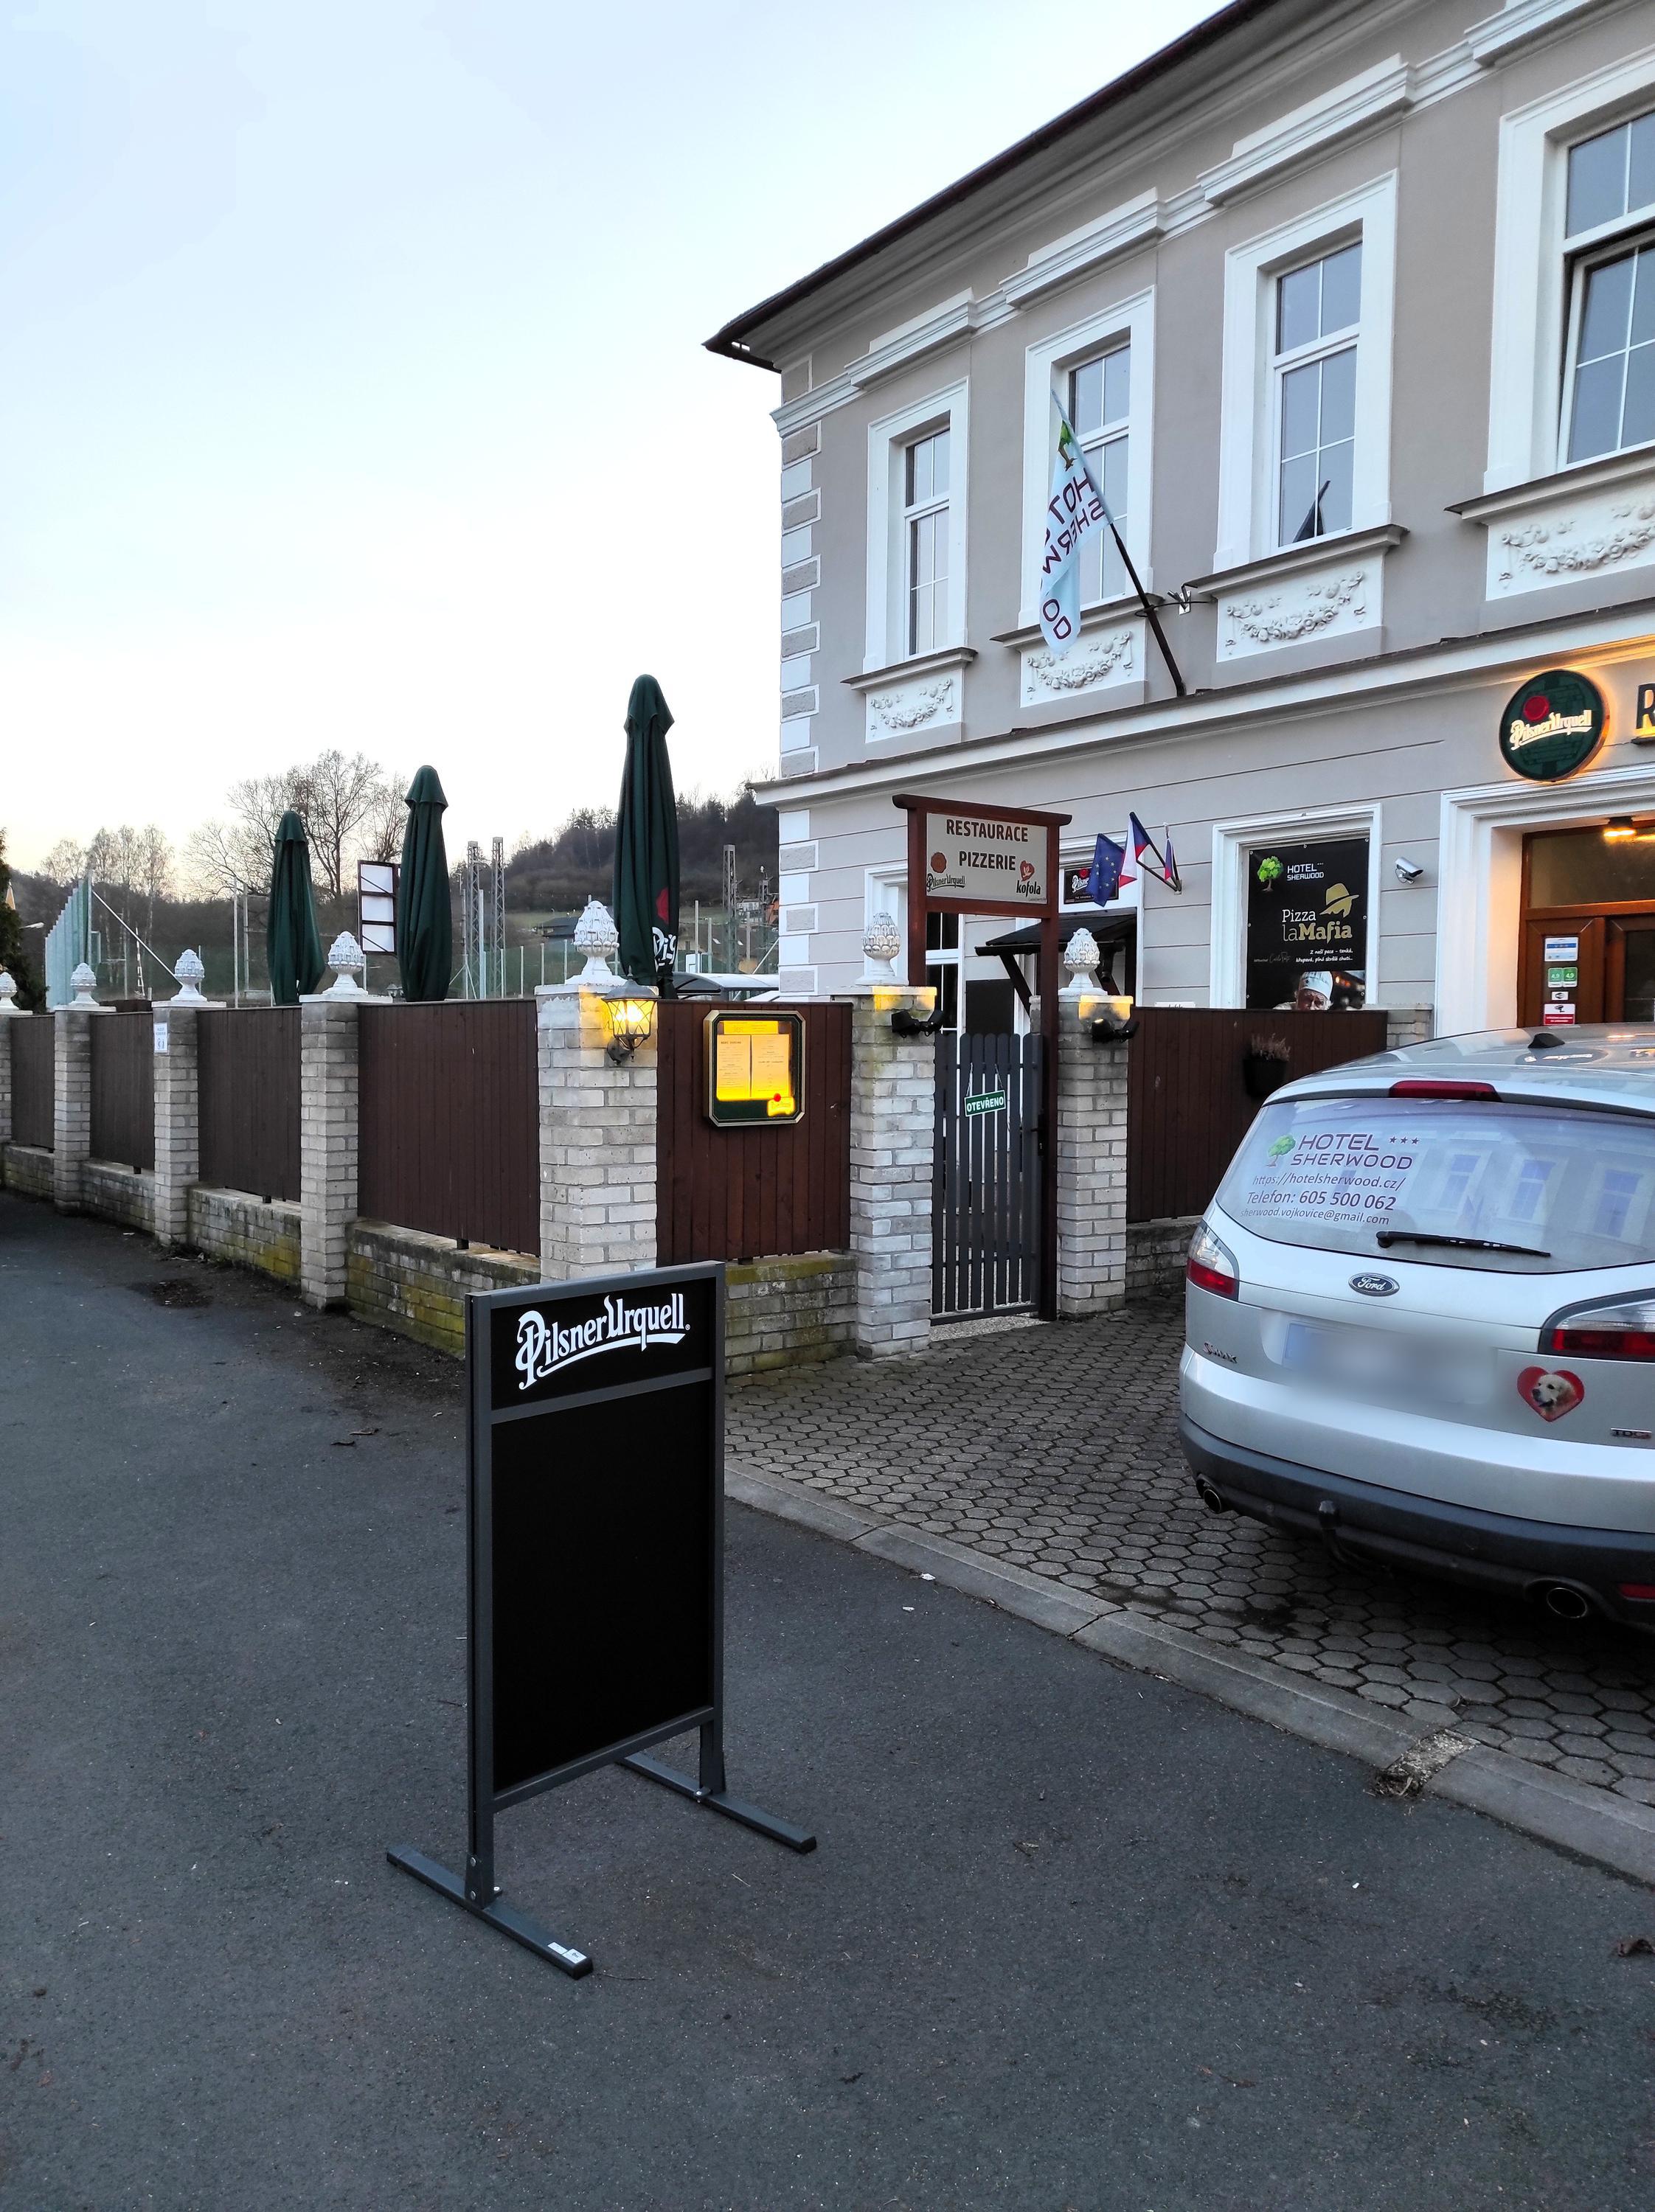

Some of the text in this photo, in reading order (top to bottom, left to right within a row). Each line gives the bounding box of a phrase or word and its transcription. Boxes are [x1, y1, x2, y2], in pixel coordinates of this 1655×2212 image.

[1509, 709, 1592, 751] Pilsner Urquell
[946, 819, 1029, 843] RESTAURACE
[959, 850, 1016, 872] PIZZERIE
[1287, 863, 1318, 874] HOTEL
[926, 872, 965, 893] Pilsner Urquell
[1072, 874, 1090, 893] Pilsne
[1286, 872, 1325, 881] SHERWOOD
[1016, 880, 1041, 897] kofola
[1282, 908, 1316, 923] Pizza
[1283, 921, 1353, 945] laMafia
[966, 1096, 1004, 1113] OTEVŘENO
[1297, 1133, 1380, 1151] HOTEL
[1291, 1153, 1412, 1169] SHERWOOD
[1252, 1172, 1406, 1192] https://hotelsherwood.cz/
[1246, 1189, 1396, 1211] Telefon: 605 500 062
[1240, 1207, 1389, 1225] sherwood.vojkovice@gmail.com
[1357, 1276, 1387, 1291] Ford
[515, 1293, 685, 1390] Pilsner Urquell
